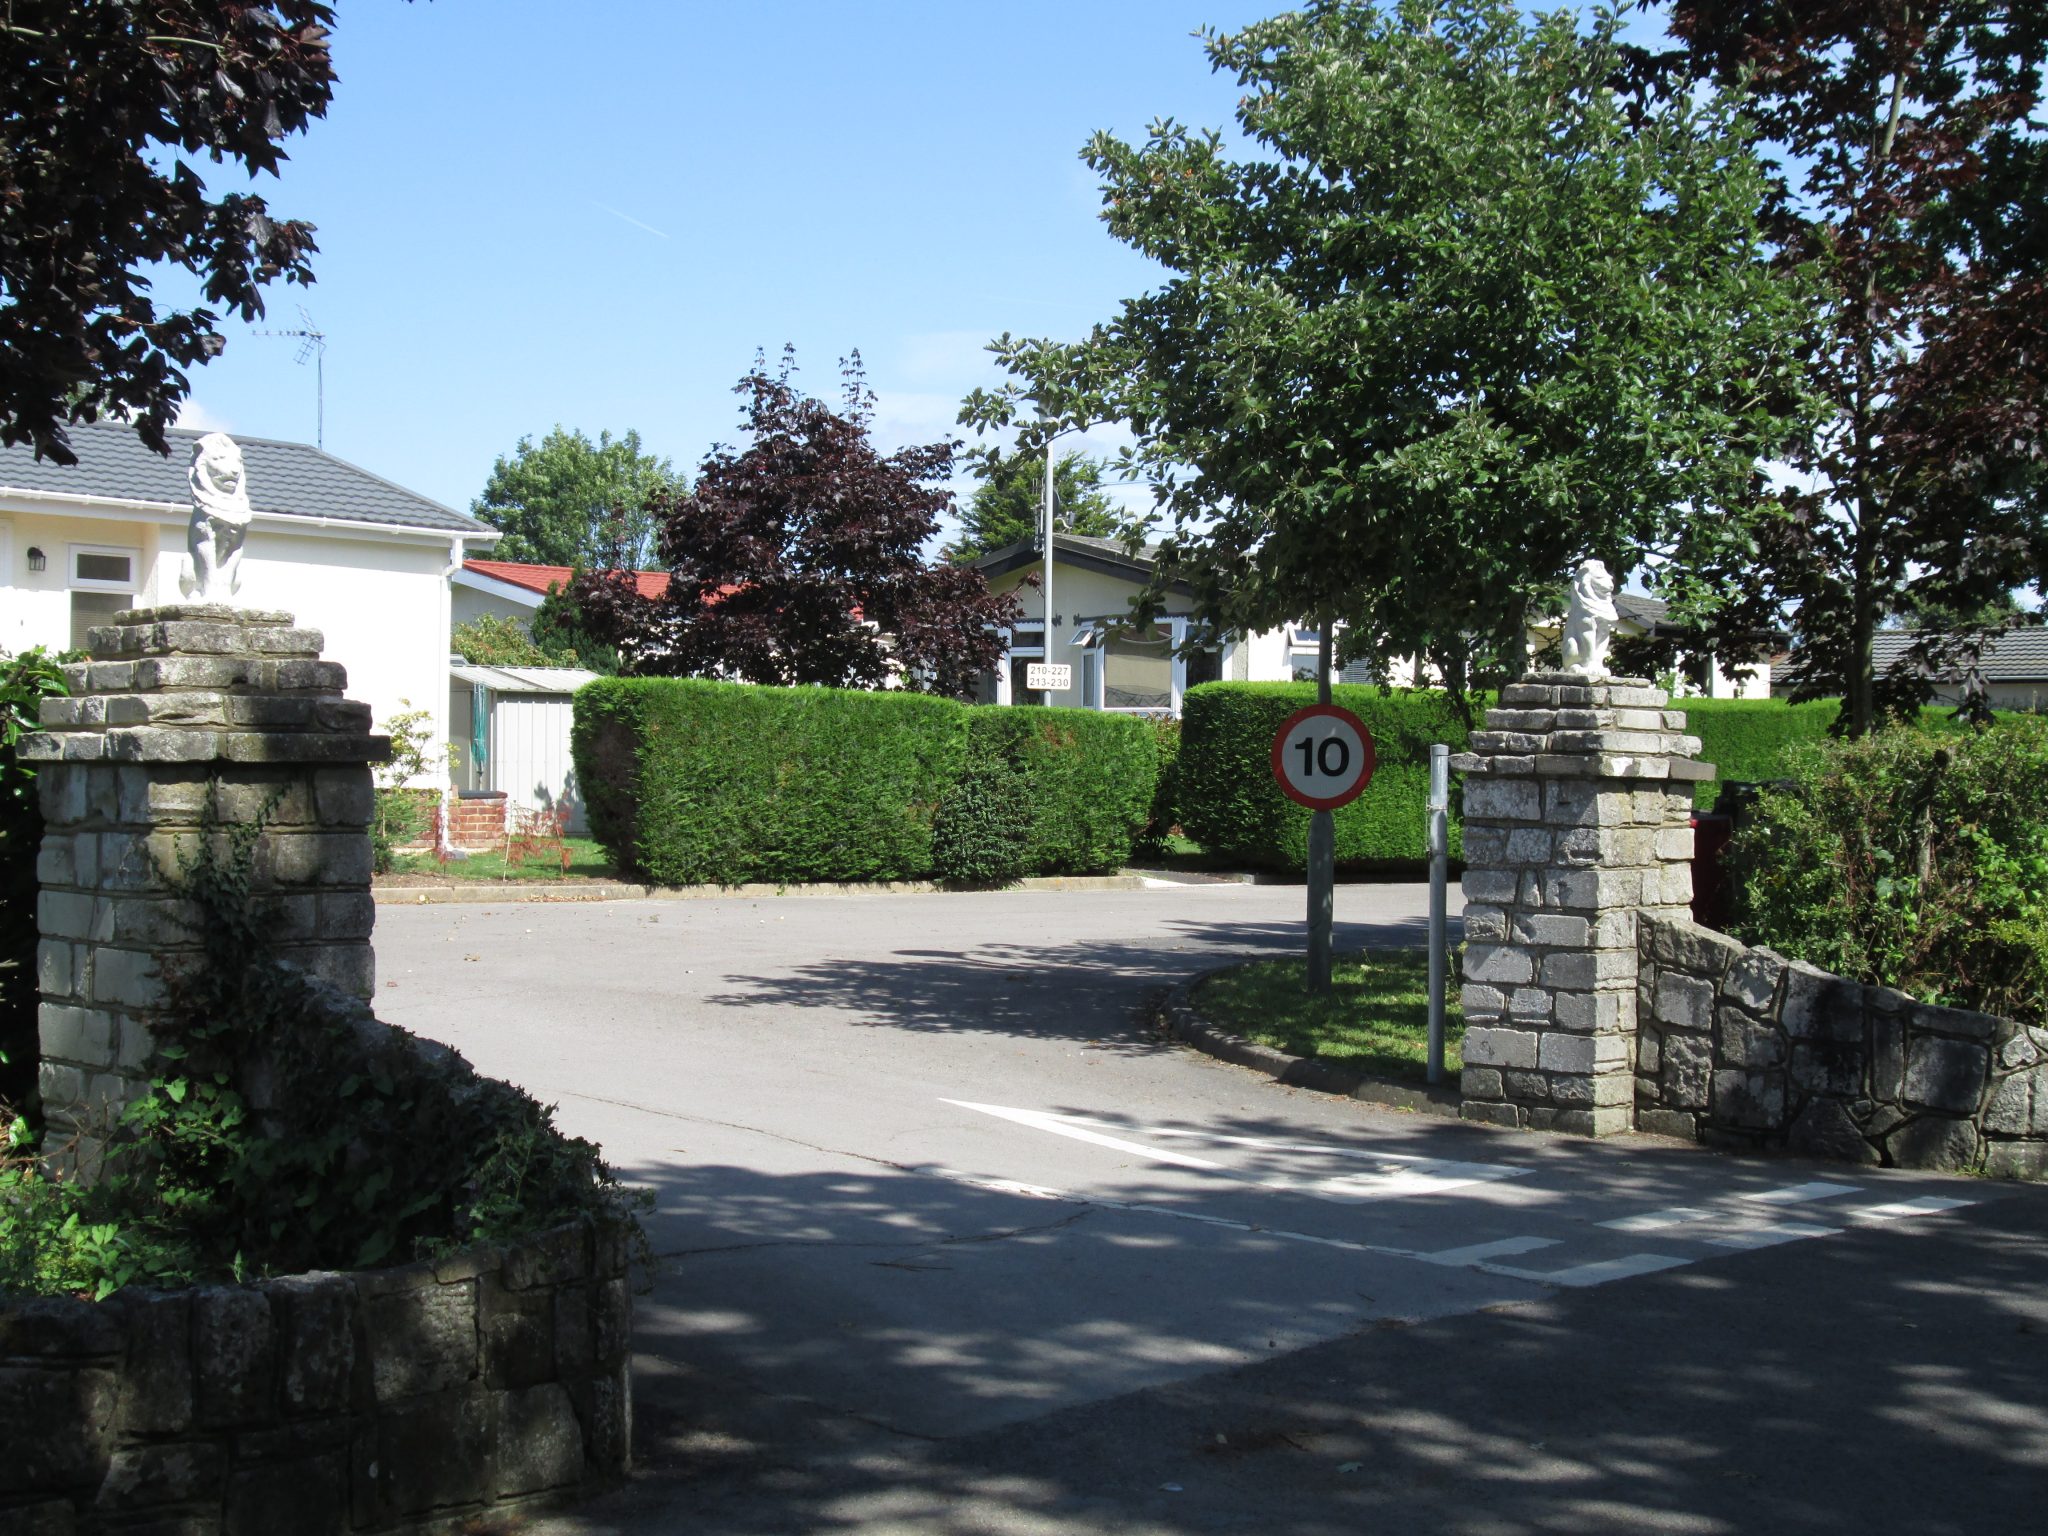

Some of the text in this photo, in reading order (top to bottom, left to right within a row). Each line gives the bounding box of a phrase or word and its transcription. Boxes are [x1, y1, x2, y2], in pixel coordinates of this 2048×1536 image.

[1030, 666, 1068, 675] 210-227
[1029, 677, 1069, 687] 213-230
[1295, 737, 1350, 777] 10
